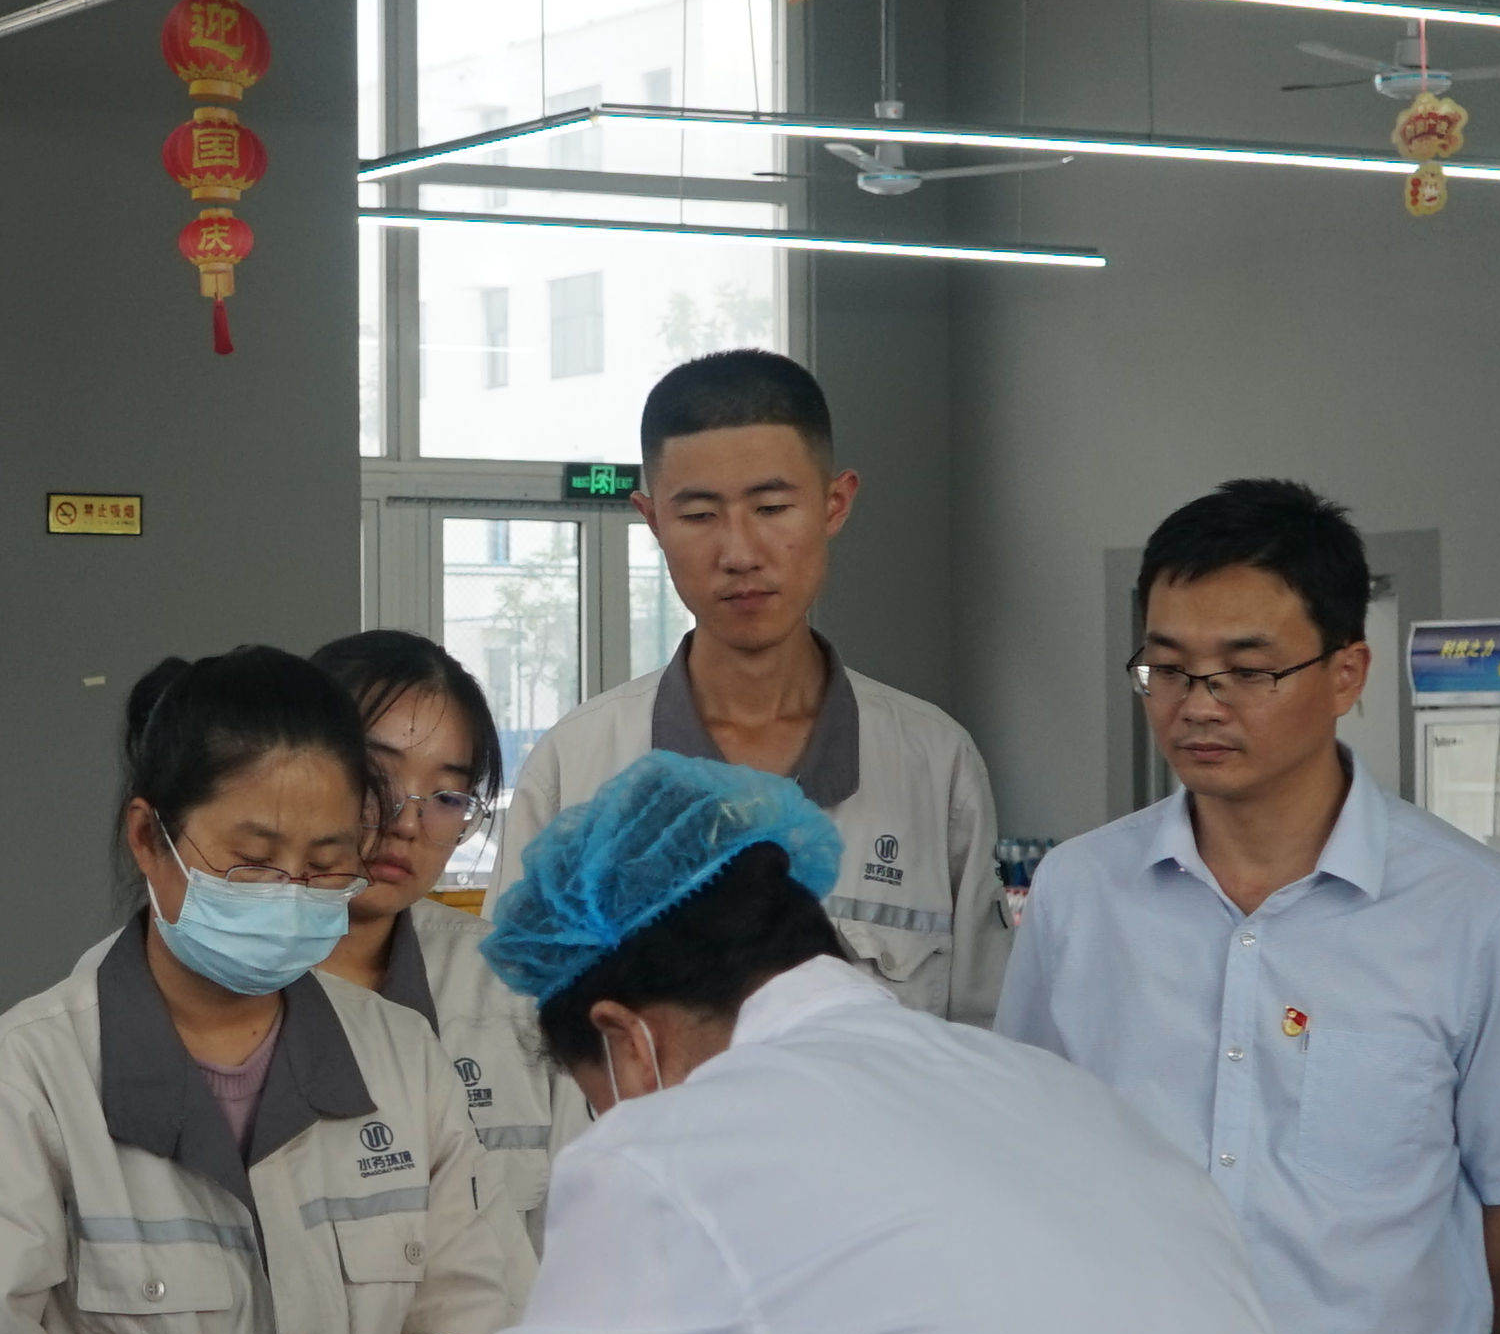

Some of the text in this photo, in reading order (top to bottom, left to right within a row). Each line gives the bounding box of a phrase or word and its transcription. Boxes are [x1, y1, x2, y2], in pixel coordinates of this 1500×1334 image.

[189, 3, 245, 60] 迎
[192, 128, 240, 168] 国
[198, 224, 232, 251] 庆
[84, 503, 135, 519] 禁止吸烟
